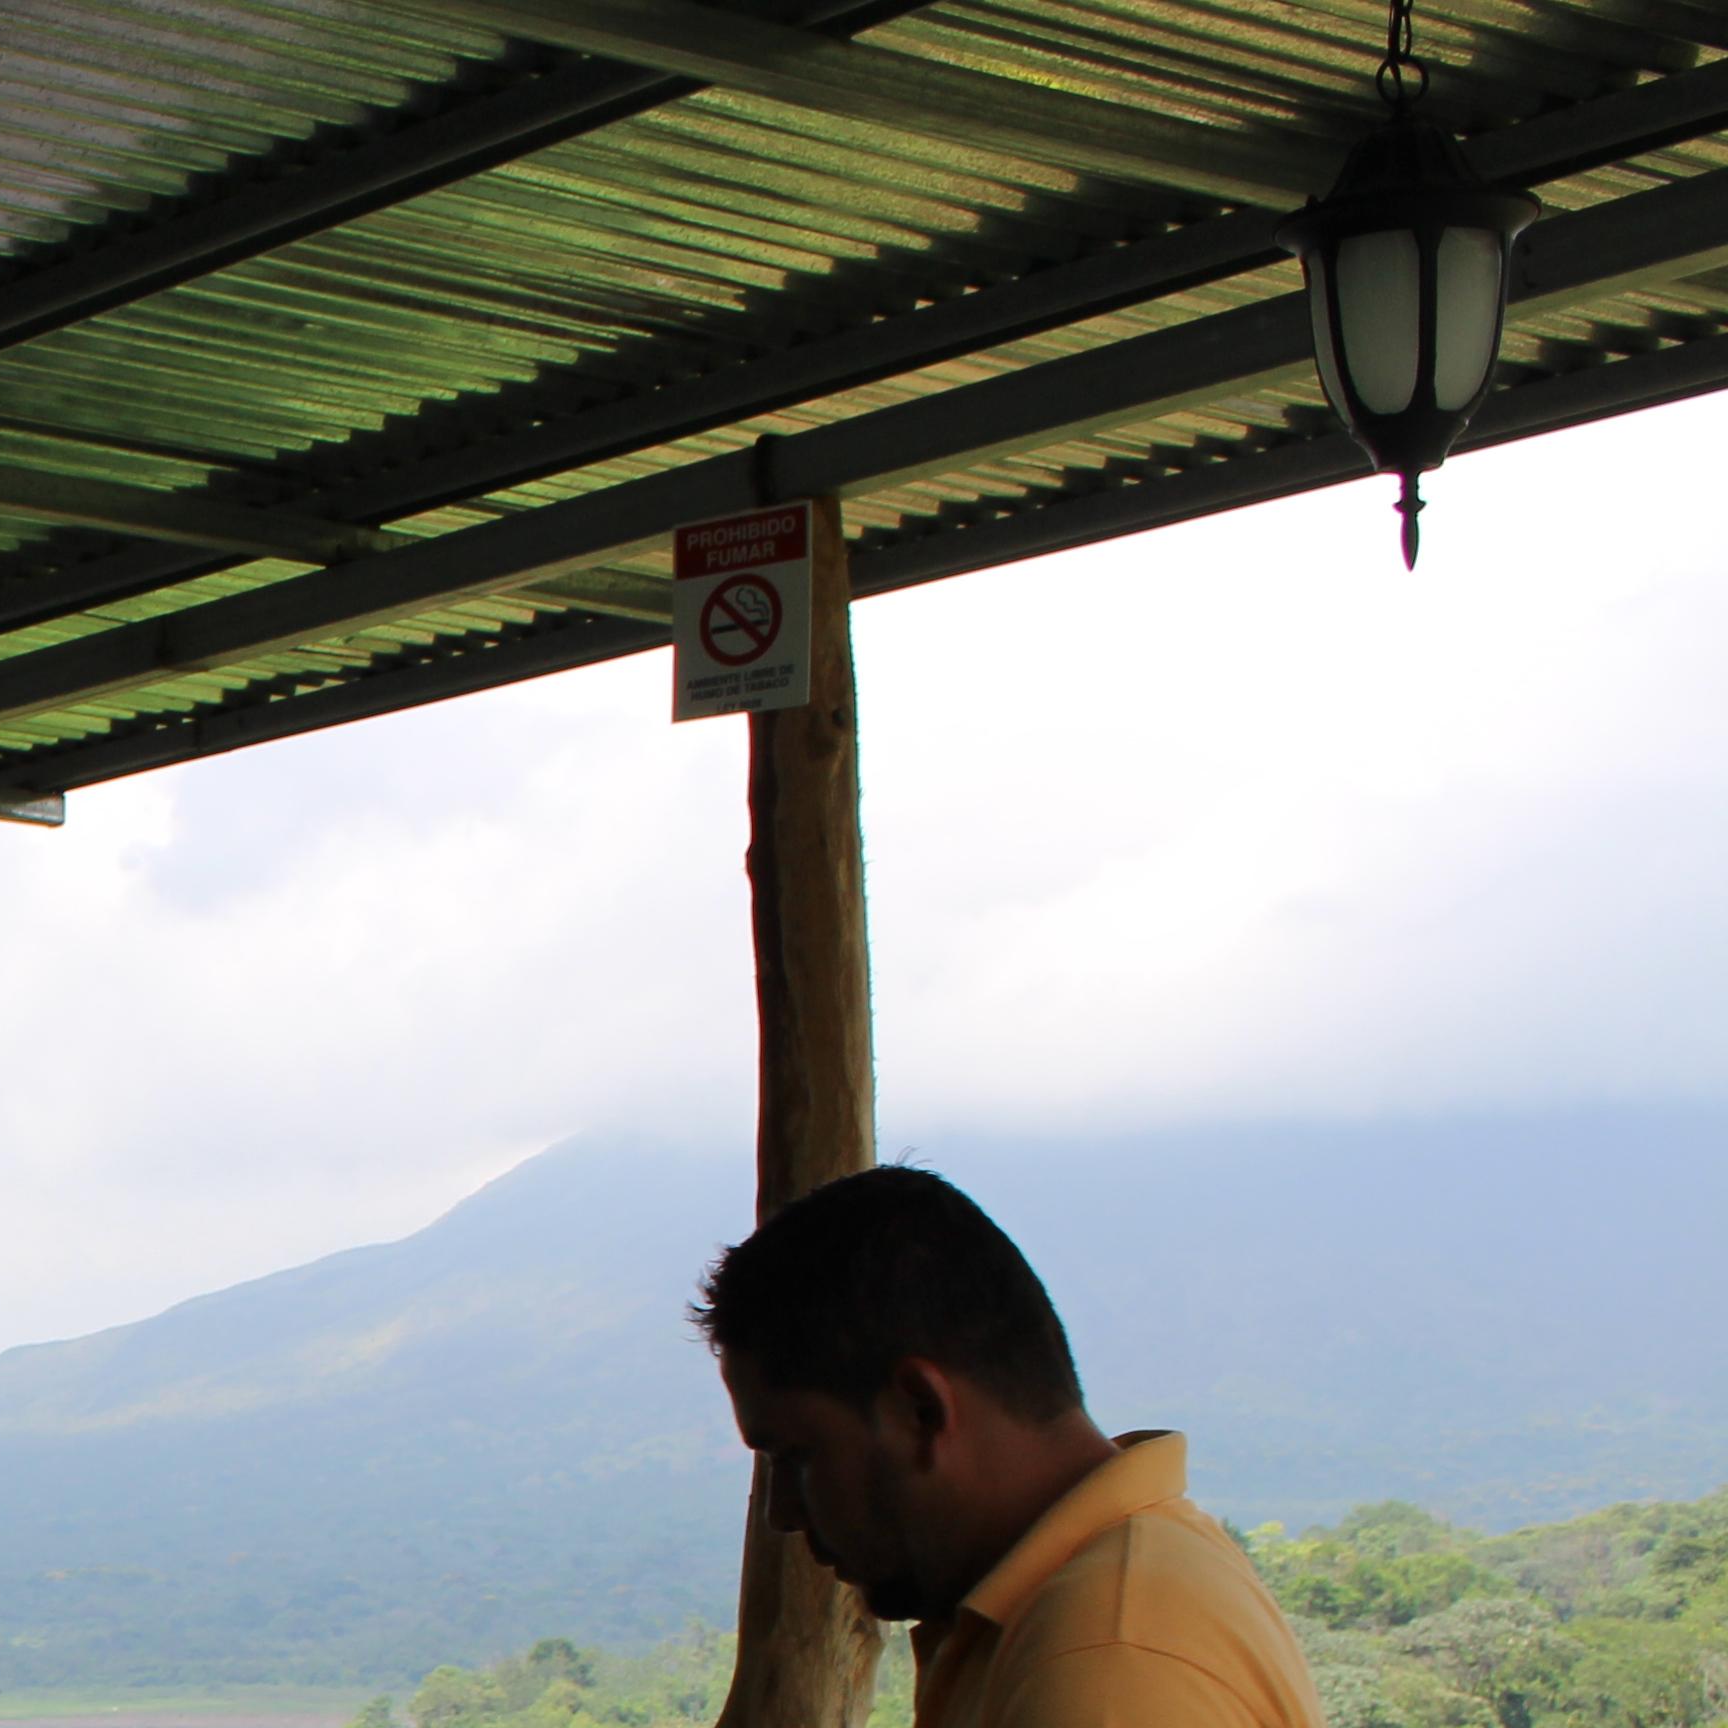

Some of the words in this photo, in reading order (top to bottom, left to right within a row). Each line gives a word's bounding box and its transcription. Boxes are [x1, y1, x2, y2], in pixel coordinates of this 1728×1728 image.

[686, 514, 796, 552] PROHIBIDO
[706, 540, 776, 569] FUMAR
[744, 677, 790, 695] TABACO
